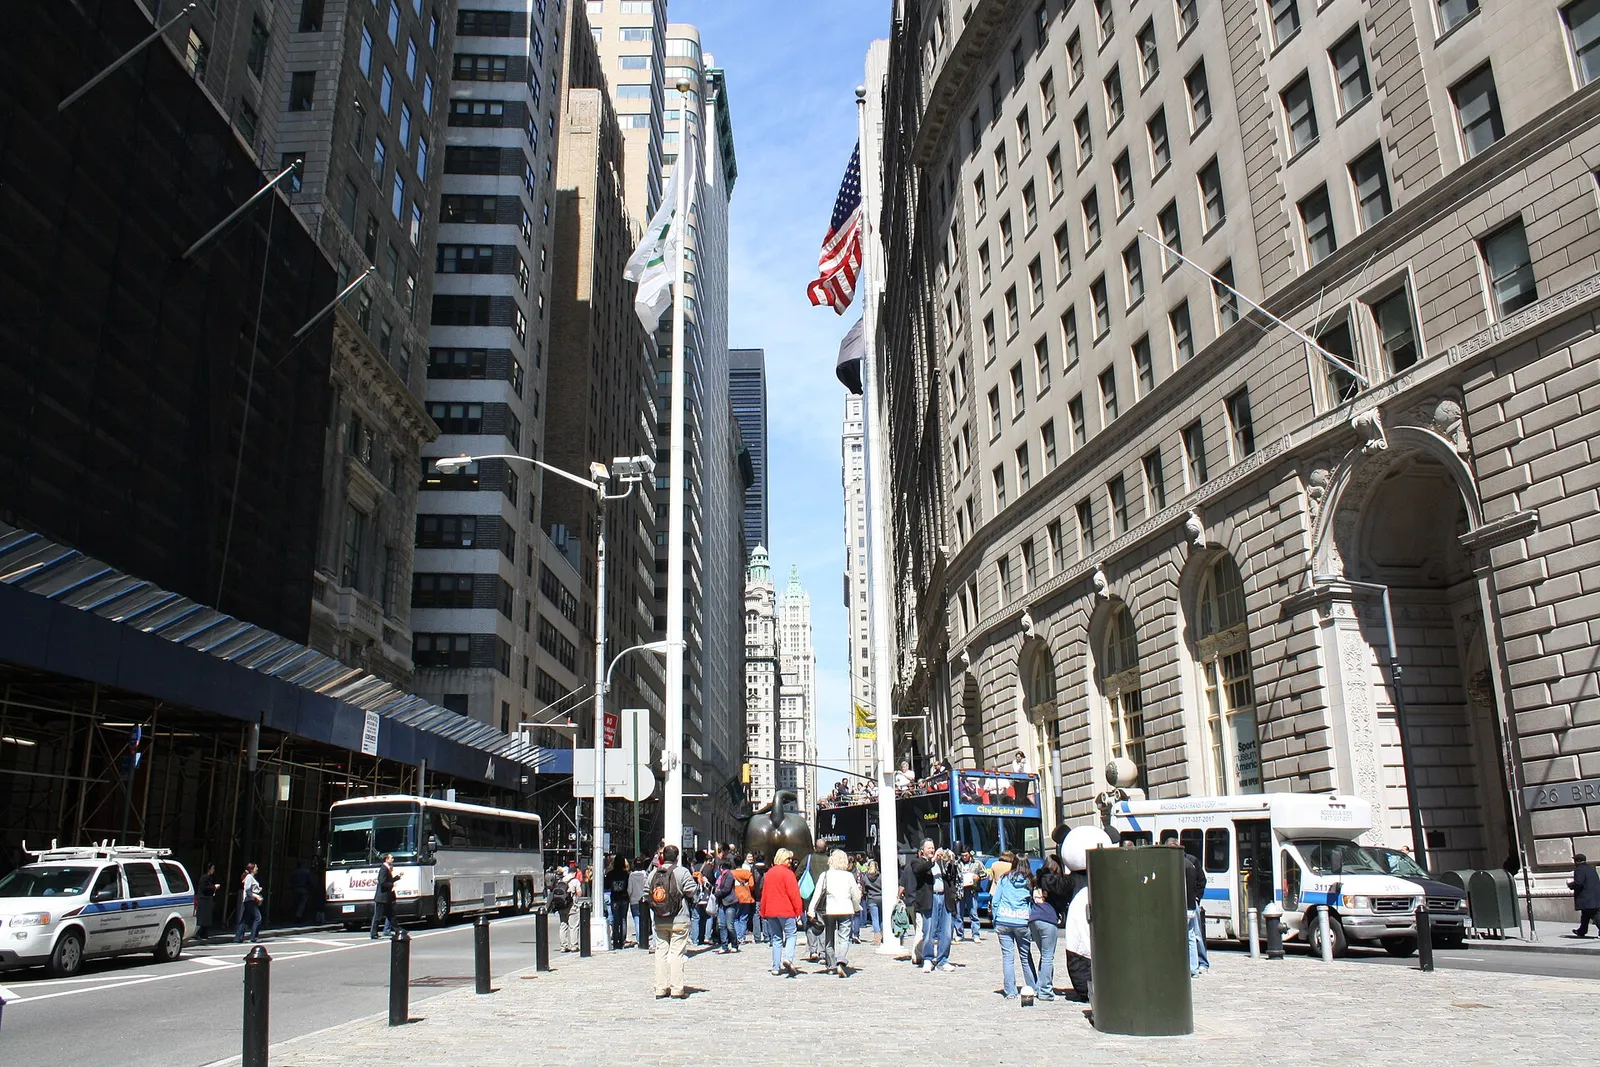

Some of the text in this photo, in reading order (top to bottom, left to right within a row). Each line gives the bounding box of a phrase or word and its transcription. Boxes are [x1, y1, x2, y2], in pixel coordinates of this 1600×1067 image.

[1238, 740, 1256, 752] Sport
[1235, 760, 1258, 771] Americ
[1539, 784, 1600, 804] 26 BR
[977, 805, 1024, 816] CitySights NY
[349, 876, 377, 888] buses
[1315, 883, 1332, 891] 3117
